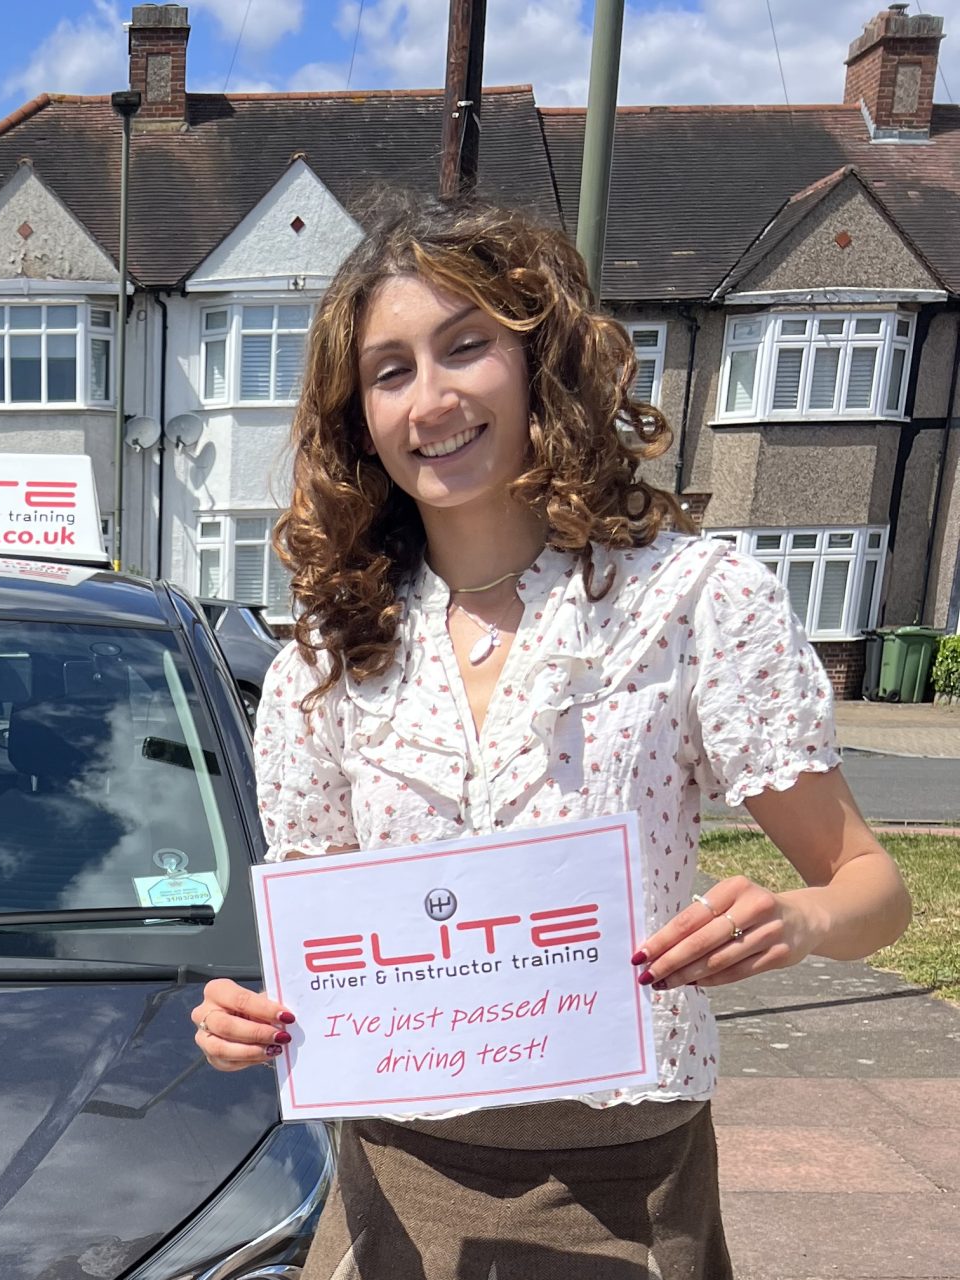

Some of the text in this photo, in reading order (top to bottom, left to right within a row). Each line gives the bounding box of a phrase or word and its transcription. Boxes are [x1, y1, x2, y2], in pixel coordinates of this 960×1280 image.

[9, 510, 76, 525] training
[302, 903, 602, 974] ELITE
[310, 946, 600, 992] driver & instructor training
[324, 989, 598, 1038] I've just passed my
[376, 1035, 549, 1077] driving test!
